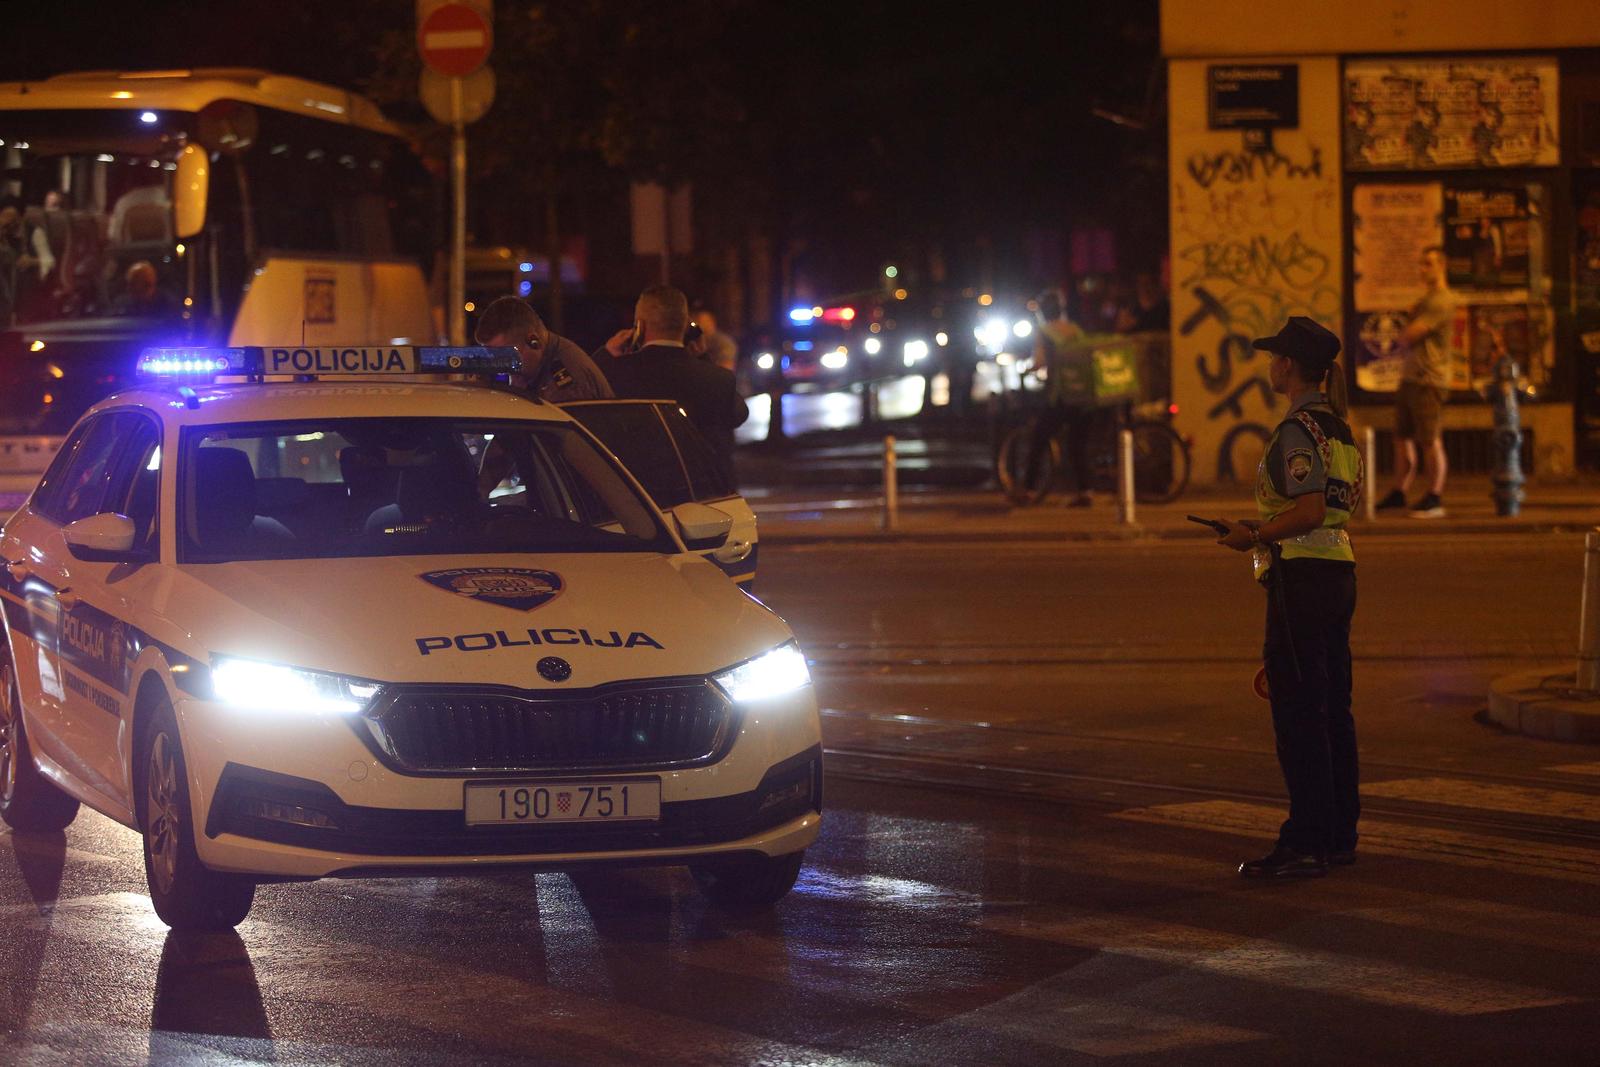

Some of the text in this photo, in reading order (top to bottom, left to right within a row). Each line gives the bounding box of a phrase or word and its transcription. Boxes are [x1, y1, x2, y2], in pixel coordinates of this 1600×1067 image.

[272, 348, 406, 371] POLICIJA
[428, 568, 552, 578] POLICIJA
[63, 613, 105, 660] POLICIJA
[415, 628, 665, 656] POLICIJA
[499, 785, 628, 819] 190 751
